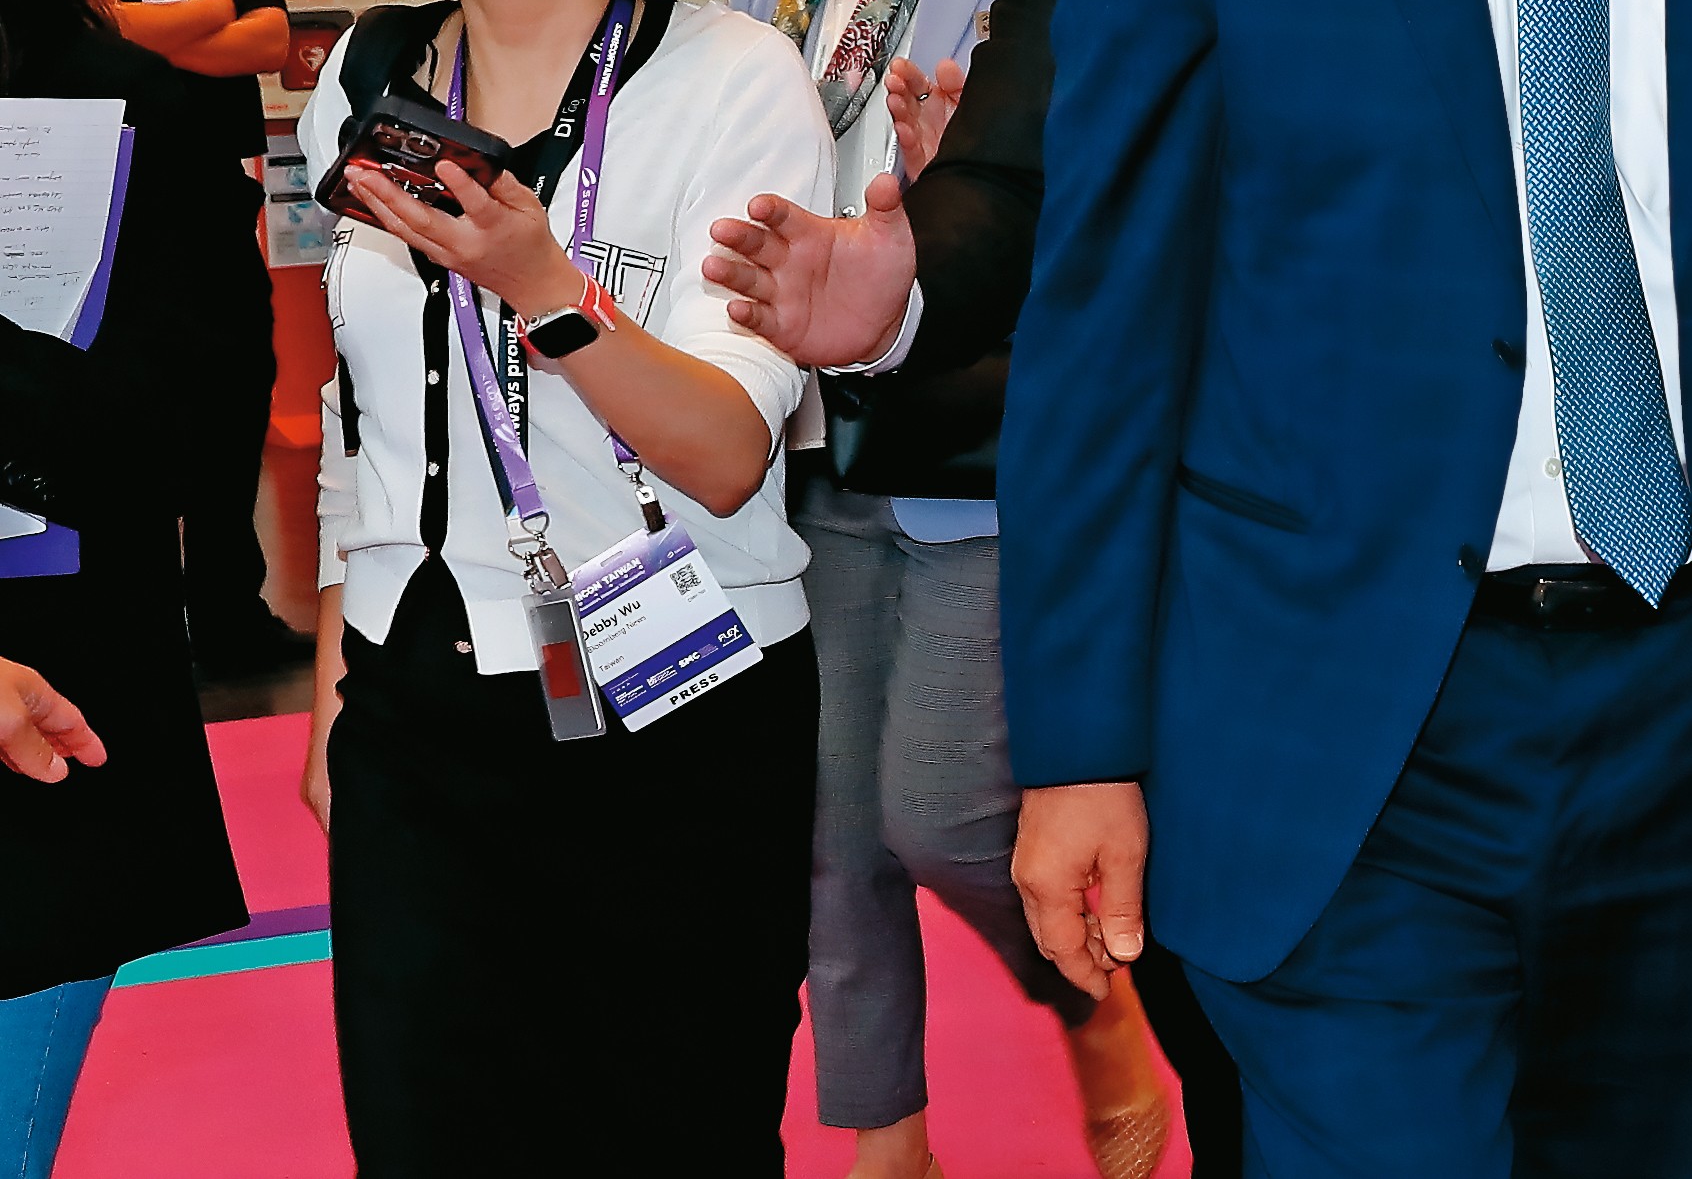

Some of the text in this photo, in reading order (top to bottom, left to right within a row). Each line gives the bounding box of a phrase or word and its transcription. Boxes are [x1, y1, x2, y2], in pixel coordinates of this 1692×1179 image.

[507, 381, 525, 444] ways
[601, 557, 642, 585] TAIWAN
[582, 600, 642, 642] Debby Wu
[598, 655, 625, 672] Taiwan
[669, 673, 720, 706] PRESS
